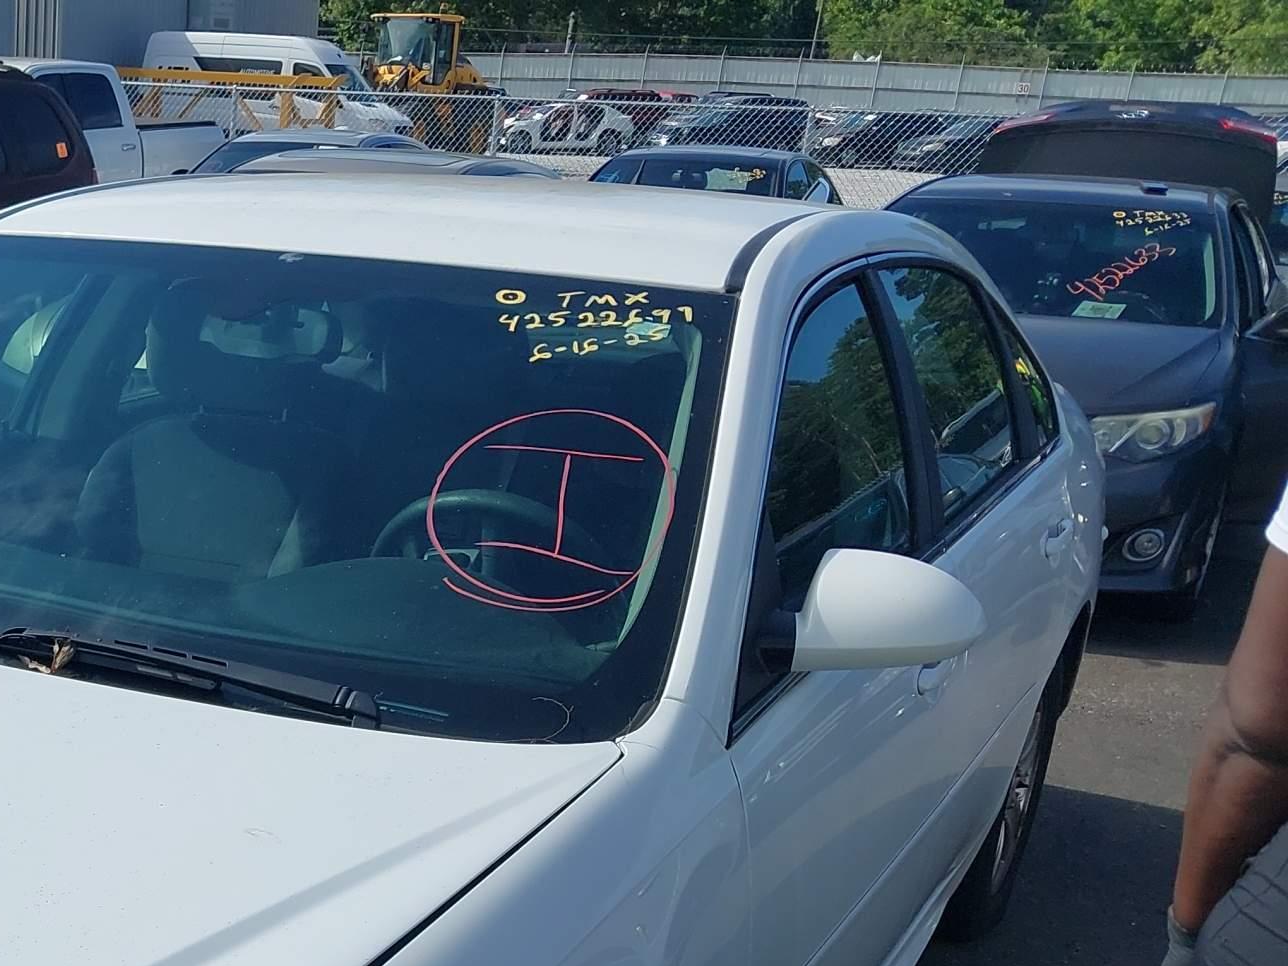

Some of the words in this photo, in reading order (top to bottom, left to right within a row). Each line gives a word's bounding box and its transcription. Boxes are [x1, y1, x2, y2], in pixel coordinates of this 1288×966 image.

[1017, 84, 1030, 93] 30
[557, 291, 649, 308] TMX
[528, 325, 671, 363] 6-16-25
